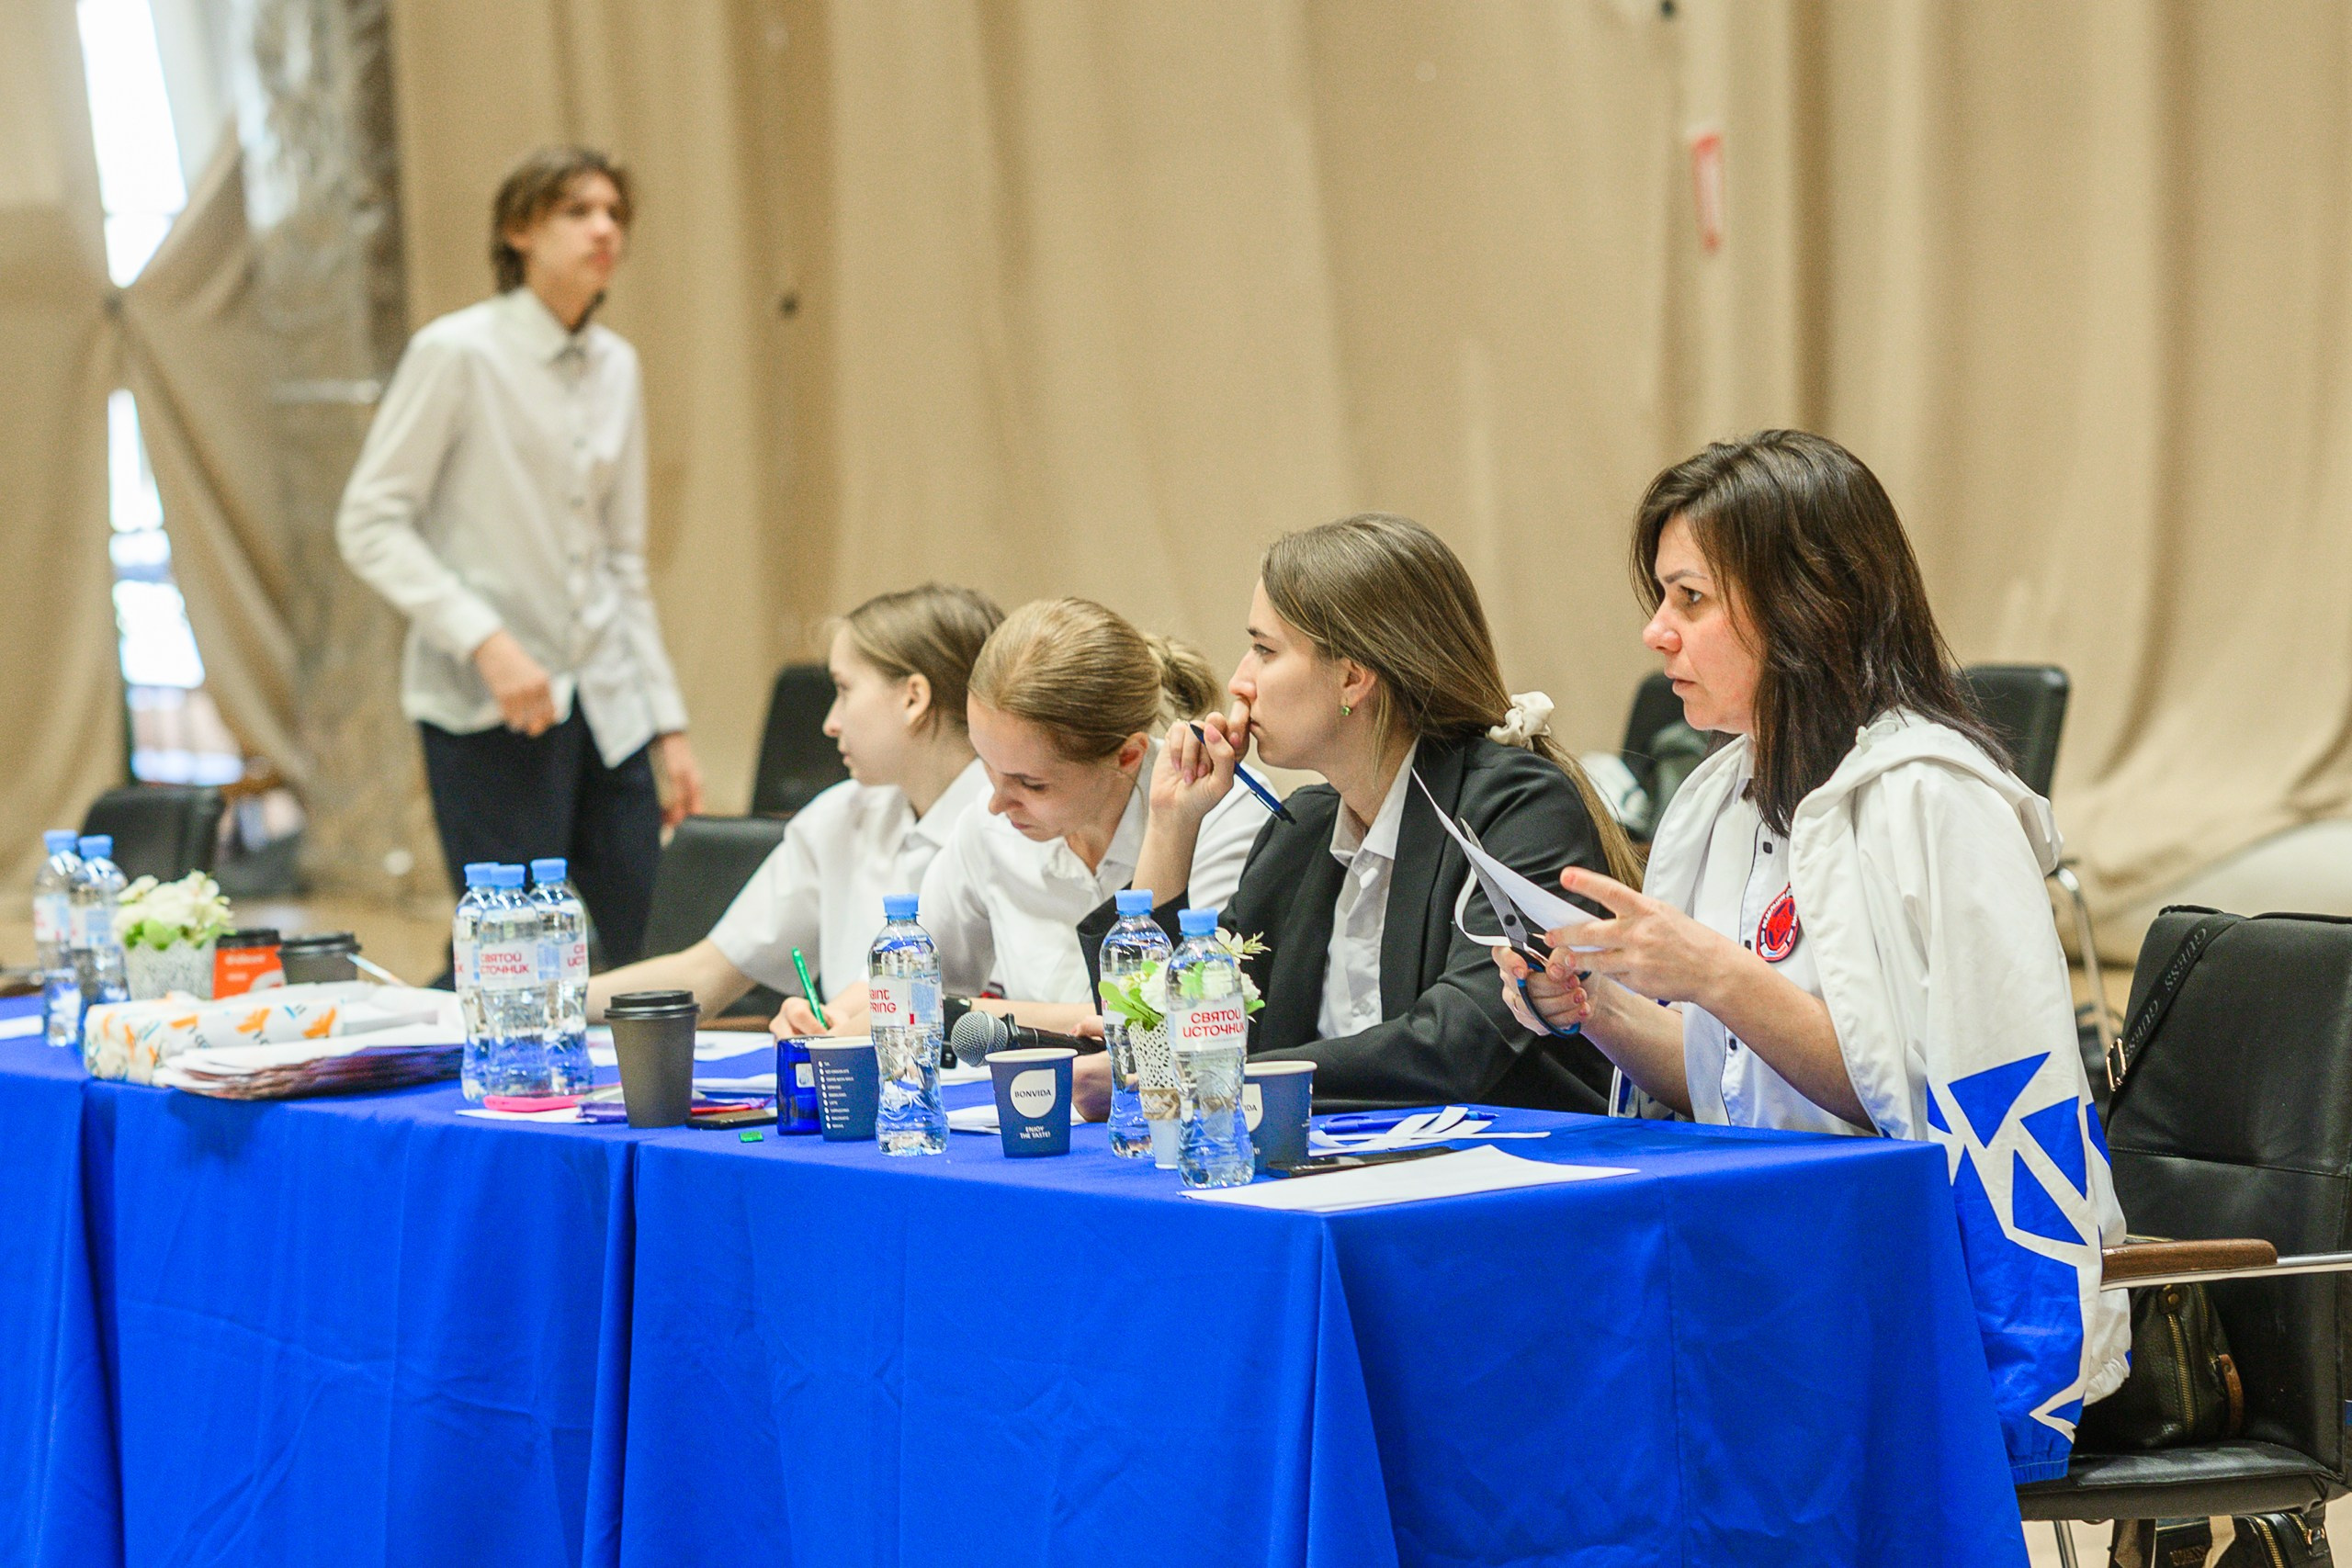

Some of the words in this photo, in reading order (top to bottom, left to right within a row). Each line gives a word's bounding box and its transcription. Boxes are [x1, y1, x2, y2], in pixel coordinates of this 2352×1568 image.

[2165, 927, 2207, 991] GUESS
[480, 964, 529, 976] СТОЧНИК
[1191, 1007, 1241, 1024] СВЯТОЙ
[1014, 1089, 1051, 1098] BONVIDA
